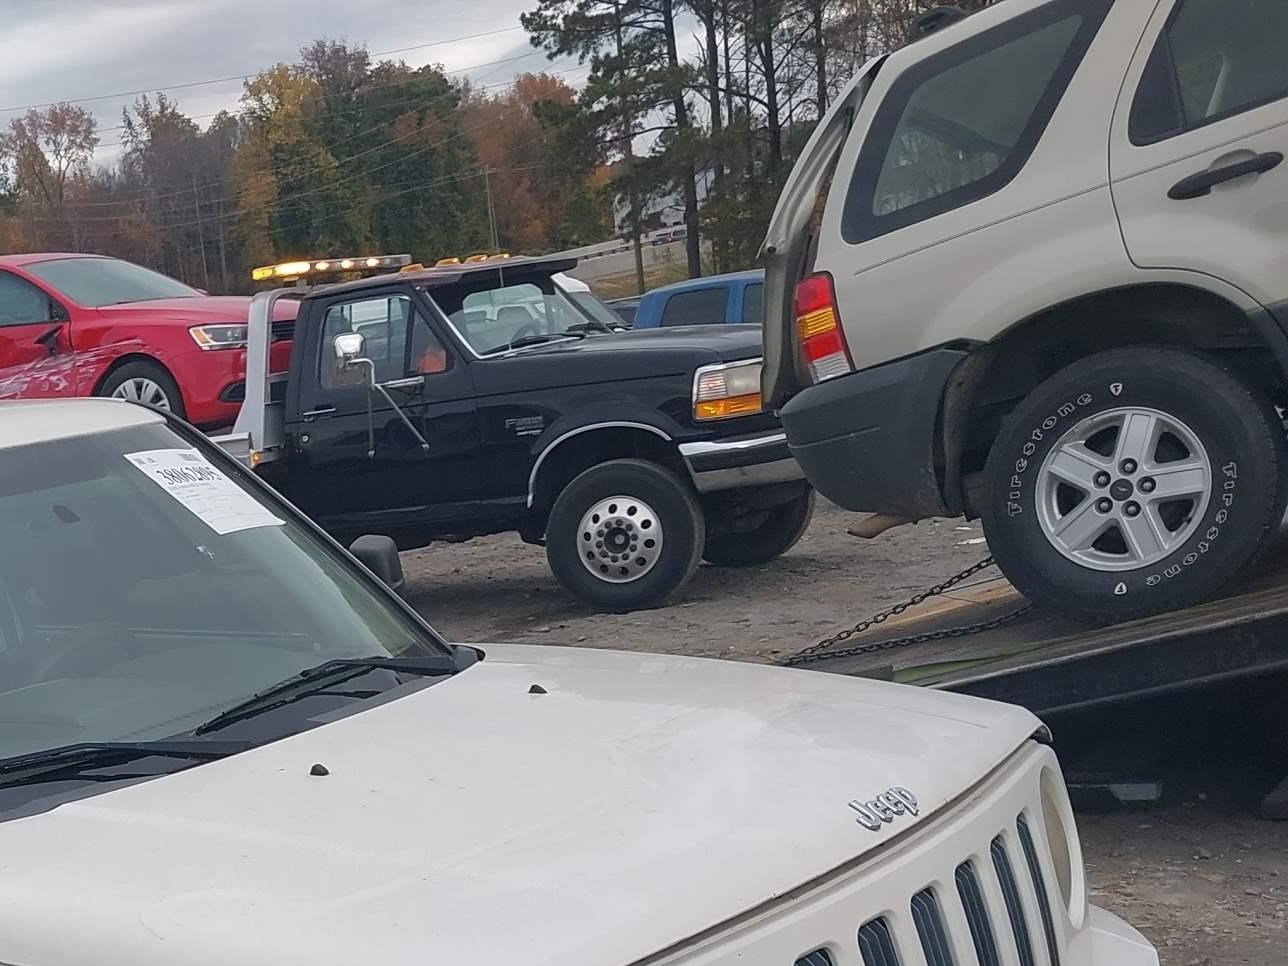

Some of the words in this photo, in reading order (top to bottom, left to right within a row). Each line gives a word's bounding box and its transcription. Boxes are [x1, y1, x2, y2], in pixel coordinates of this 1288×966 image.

[1007, 393, 1092, 517] Firestone
[1145, 461, 1238, 586] Firestone
[848, 786, 920, 832] Jeep
